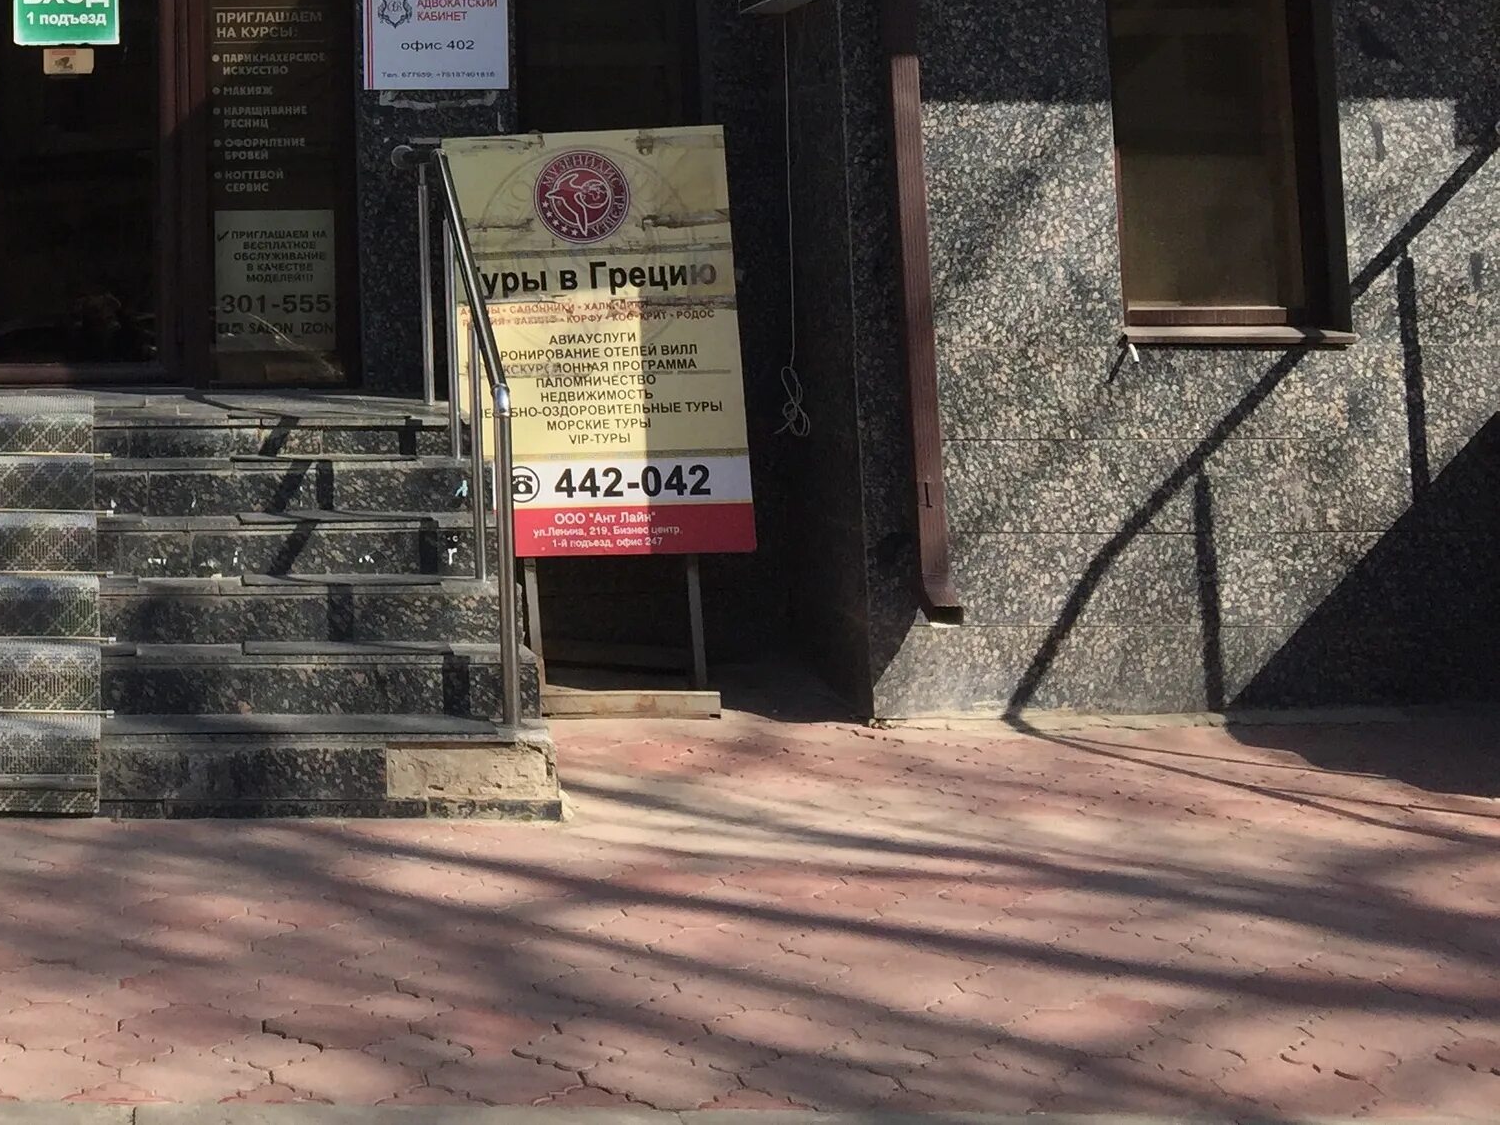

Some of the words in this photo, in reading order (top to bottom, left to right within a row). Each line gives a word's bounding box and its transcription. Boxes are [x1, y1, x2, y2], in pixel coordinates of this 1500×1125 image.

[26, 11, 34, 25] 1
[39, 13, 108, 27] подъезд
[215, 11, 323, 24] ПРИГЛАШАЕМ
[416, 10, 468, 22] КАБИНЕТ
[215, 26, 237, 38] НА
[400, 39, 442, 53] офис
[445, 39, 475, 51] 402
[222, 52, 325, 63] ПАРИКМАХЕРСКОЕ
[222, 65, 289, 76] ИСКУССТВО
[222, 85, 274, 97] МАКИЯЖ
[223, 105, 308, 116] НАРАЩИВАНИЕ
[223, 118, 269, 129] РЕСНИЦ
[224, 137, 306, 148] ОФОРМЛЕНИЕ
[224, 148, 269, 161] БРОВЕЙ
[225, 182, 269, 193] СЕРВИС
[231, 230, 309, 240] ПРИГЛАШАЕМ
[312, 229, 328, 239] НА
[243, 240, 316, 250] БЕСПЛАТНОЕ
[233, 251, 327, 261] ОБСЛУЖИВАНИЕ
[246, 262, 254, 272] В
[256, 262, 314, 272] КАЧЕСТВЕ
[476, 267, 548, 301] уры
[560, 269, 579, 291] в
[589, 261, 717, 296] Грецию
[220, 293, 332, 314] 301-555
[566, 313, 603, 324] КОРФУ
[640, 310, 667, 321] КРИТ
[676, 309, 715, 320] РОДОС
[548, 332, 637, 346] АВИАУСЛУГИ
[500, 348, 600, 362] РОНИРОВАНИЕ
[605, 343, 657, 358] ОТЕЛЕЙ
[661, 343, 698, 356] ВИЛЛ
[612, 358, 698, 372] ПРОГРАММА
[536, 374, 657, 389] ПАЛОМНИЧЕСТВО
[540, 387, 654, 404] НЕДВИЖИМОСТЬ
[685, 400, 723, 413] ТУРЫ
[547, 418, 610, 432] МОРСКИЕ
[615, 417, 652, 431] ТУРЫ
[568, 432, 631, 446] VIP-ТУРЫ
[554, 464, 712, 498] 442-042
[554, 512, 586, 525] ООО
[589, 511, 616, 524] "Ант
[613, 525, 650, 536] Бизнес
[616, 537, 644, 549] офис
[645, 536, 663, 547] 247
